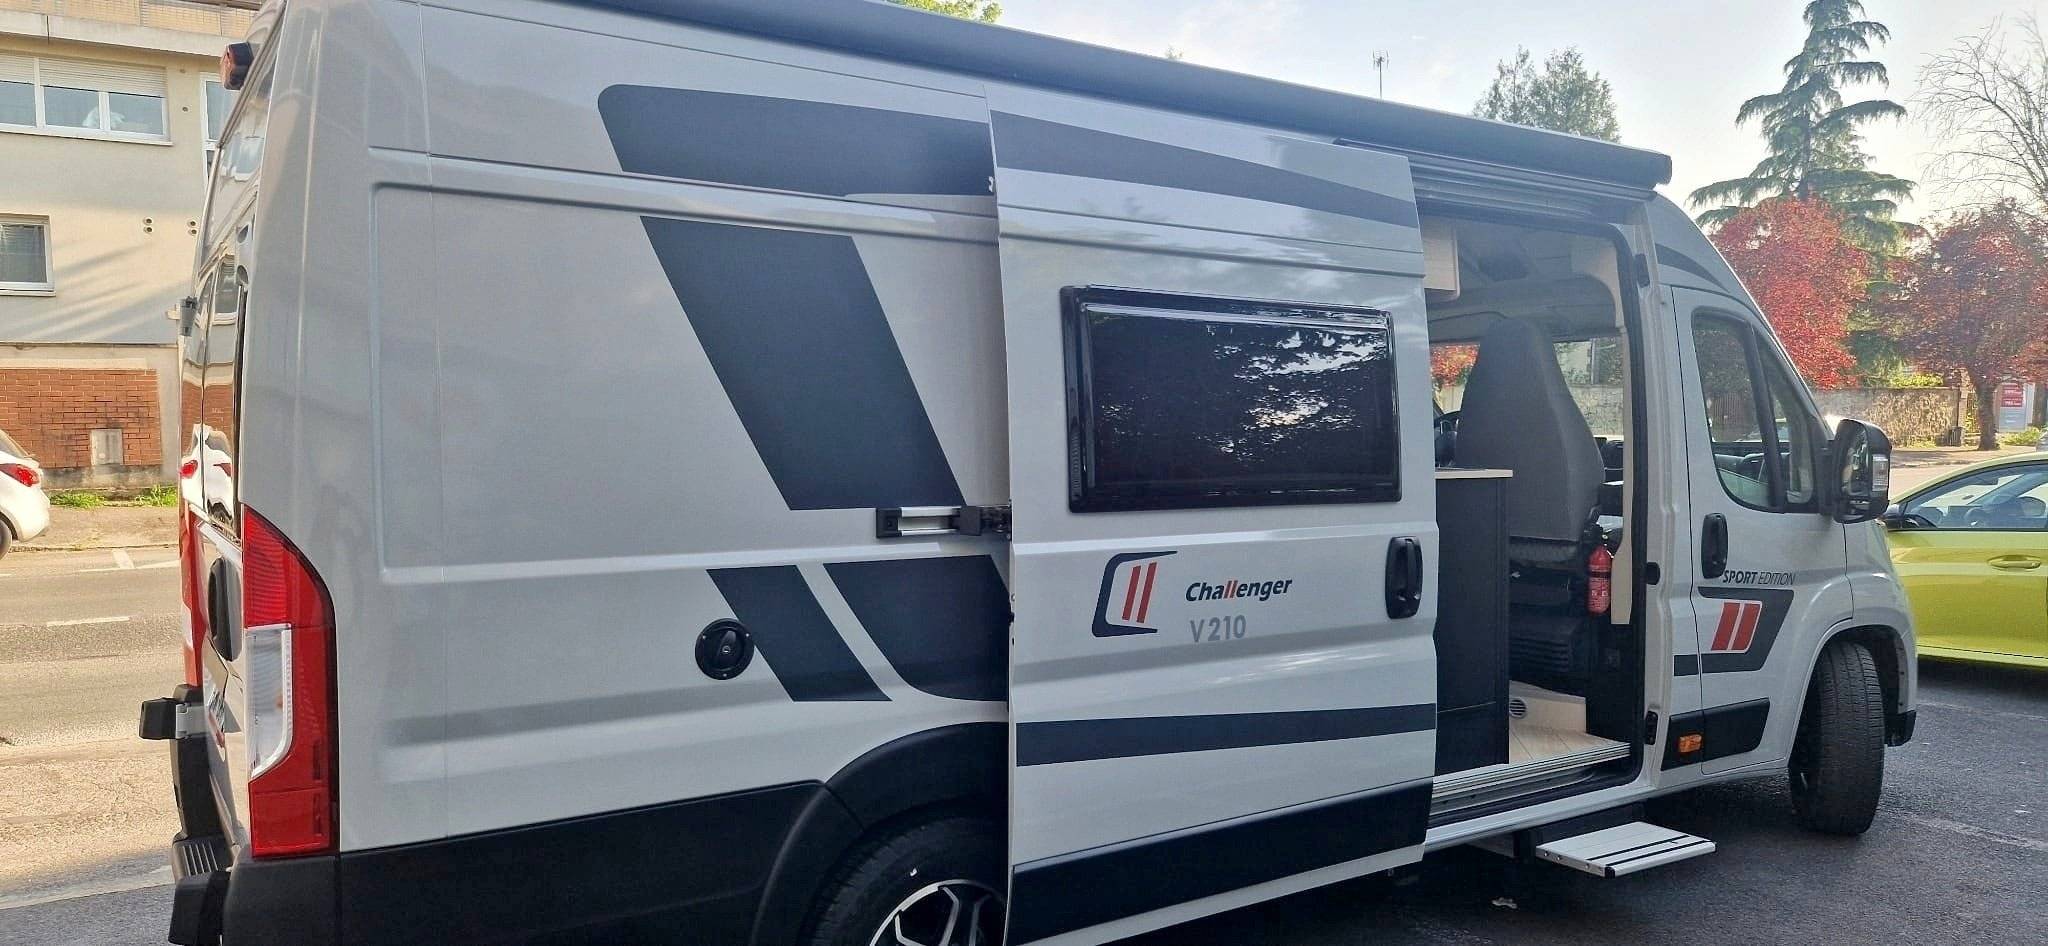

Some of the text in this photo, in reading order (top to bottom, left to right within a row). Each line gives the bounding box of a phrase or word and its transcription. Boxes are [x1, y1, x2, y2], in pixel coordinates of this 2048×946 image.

[1722, 570, 1796, 586] SPORT EDITION
[1185, 579, 1293, 602] Challenger
